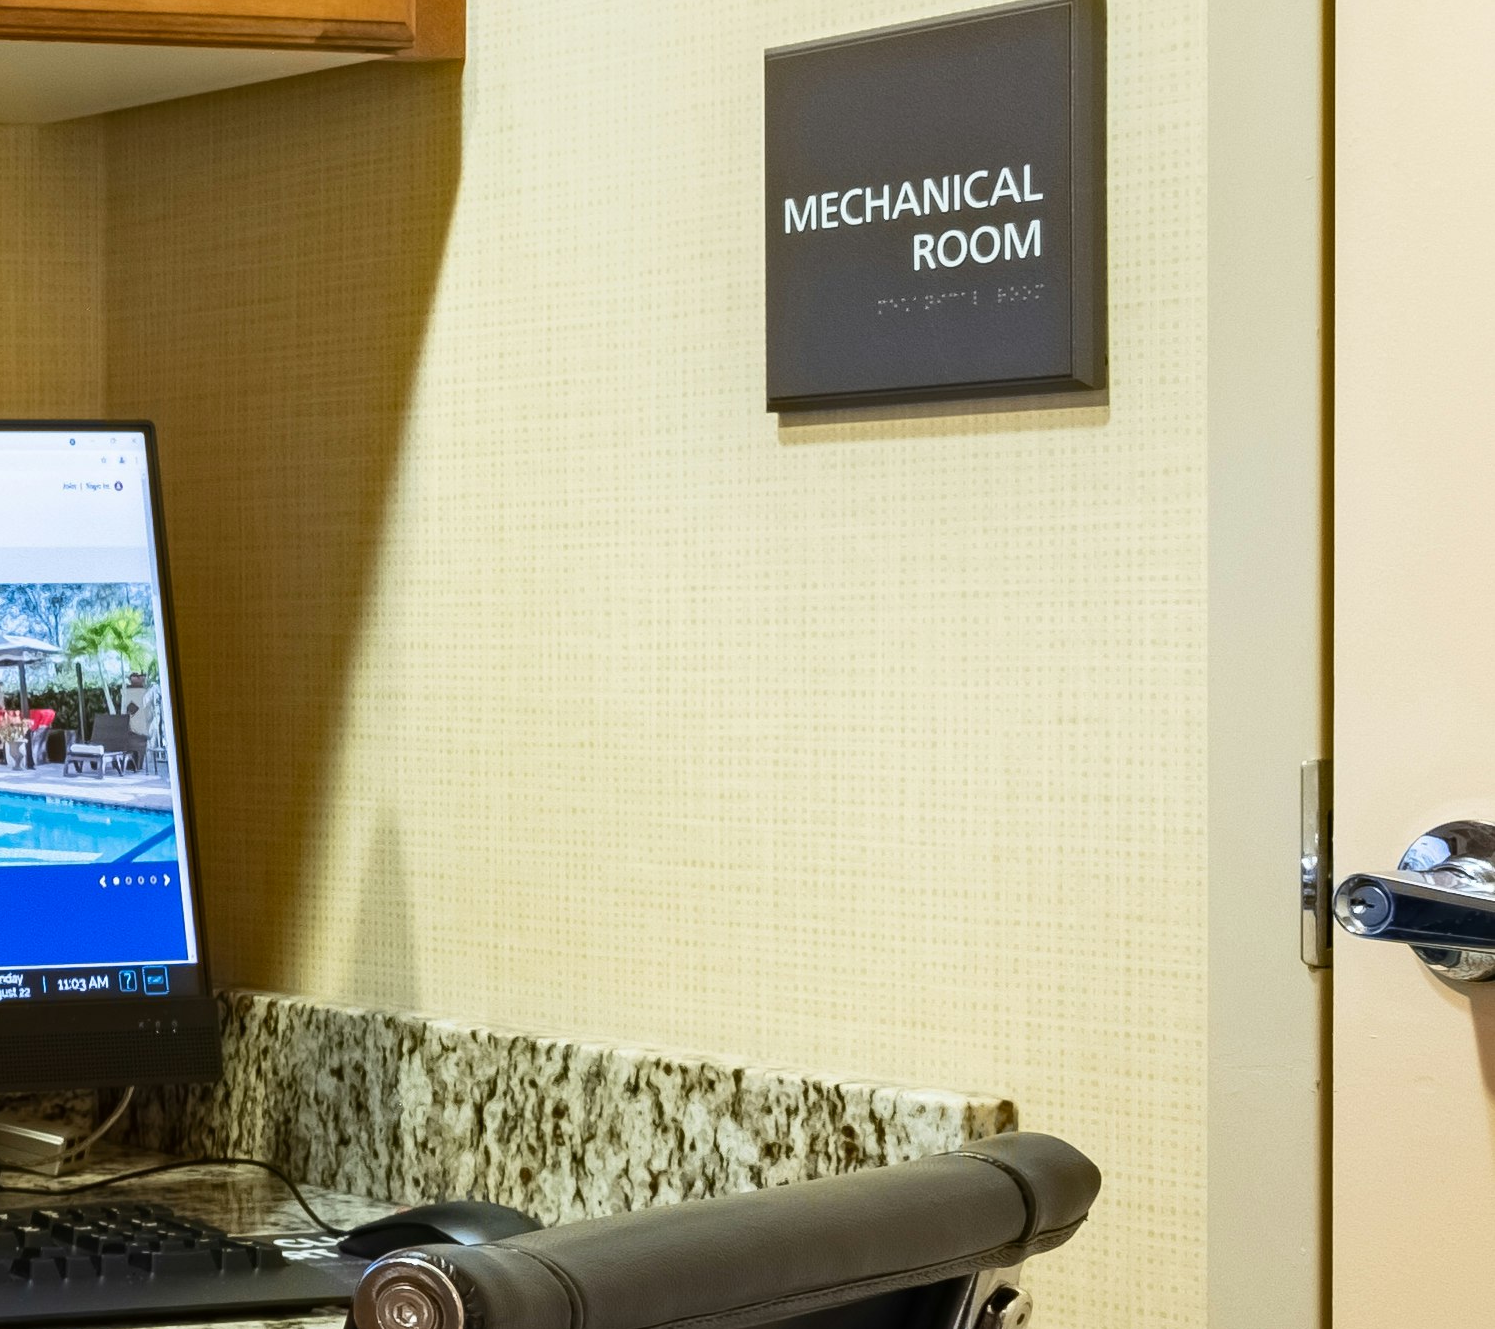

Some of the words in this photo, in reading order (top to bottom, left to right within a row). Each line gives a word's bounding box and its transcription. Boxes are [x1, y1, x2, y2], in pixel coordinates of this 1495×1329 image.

[784, 164, 1044, 234] MECHANICAL
[913, 219, 1041, 271] ROOM
[17, 987, 31, 998] 22
[56, 978, 87, 992] 11:03
[88, 976, 110, 990] AM
